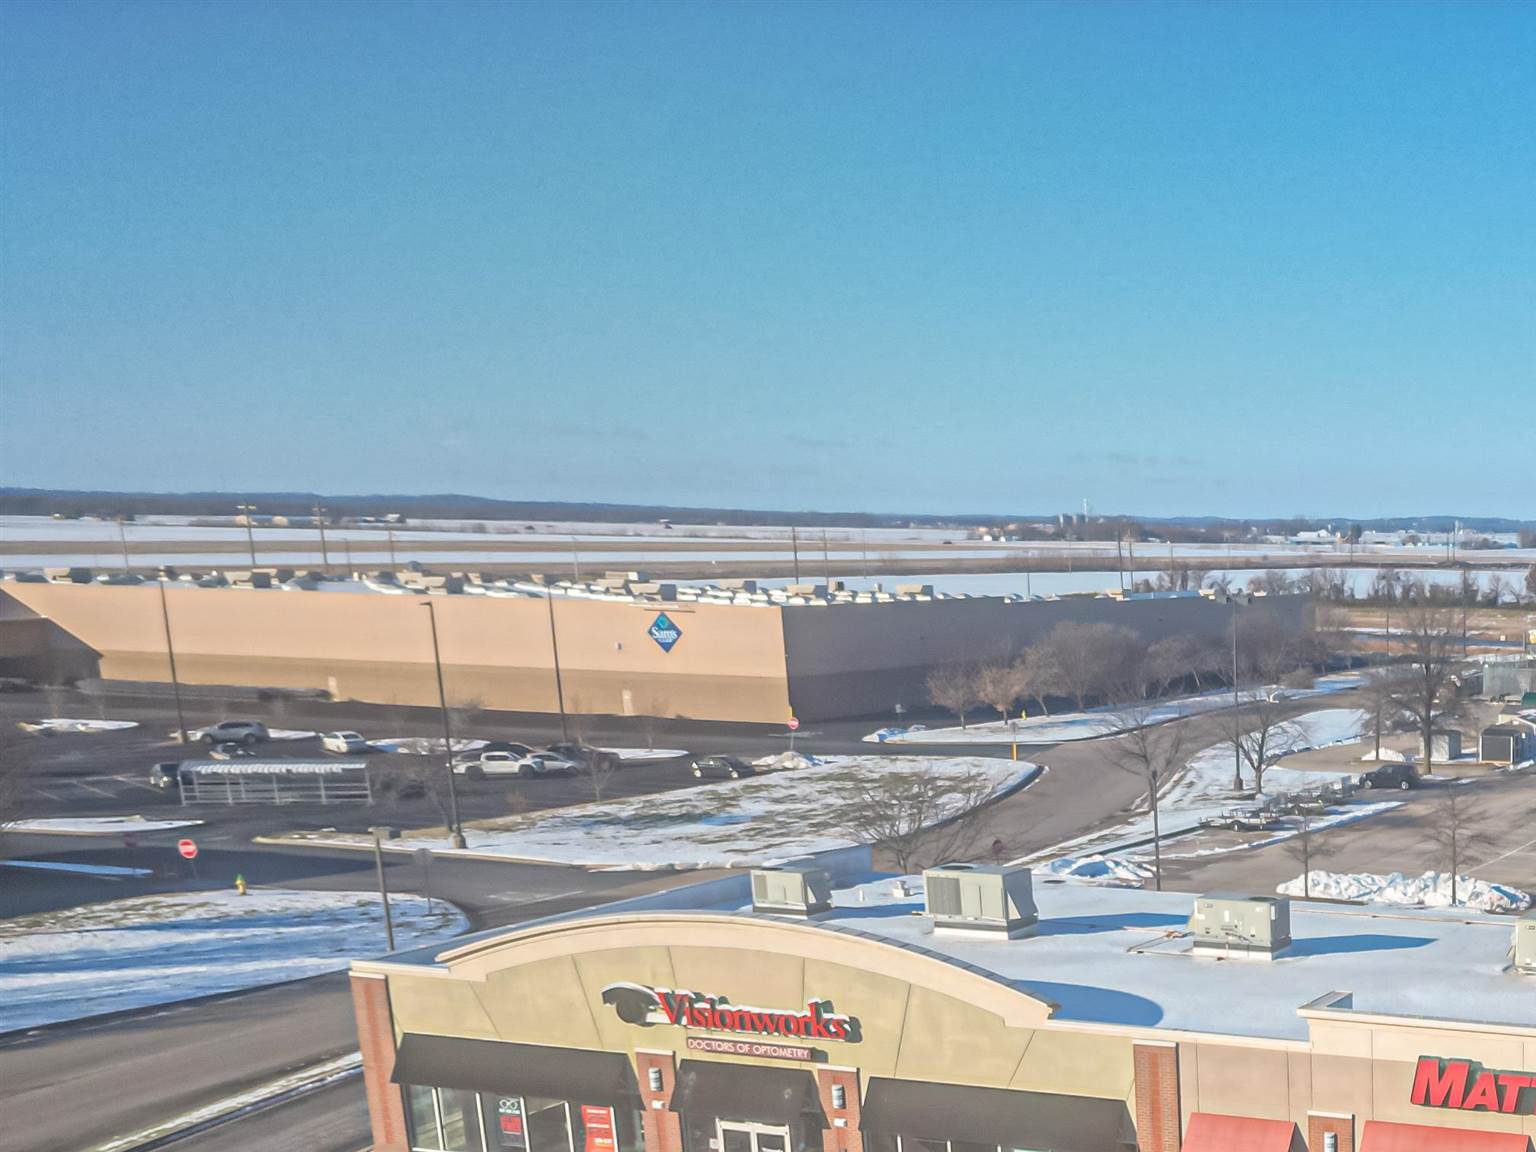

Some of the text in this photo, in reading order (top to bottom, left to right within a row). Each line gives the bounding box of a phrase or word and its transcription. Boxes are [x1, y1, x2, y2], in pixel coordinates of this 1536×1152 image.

[656, 990, 847, 1039] Visionworks
[687, 1038, 809, 1058] DOCTORS OF OPTOMETRY
